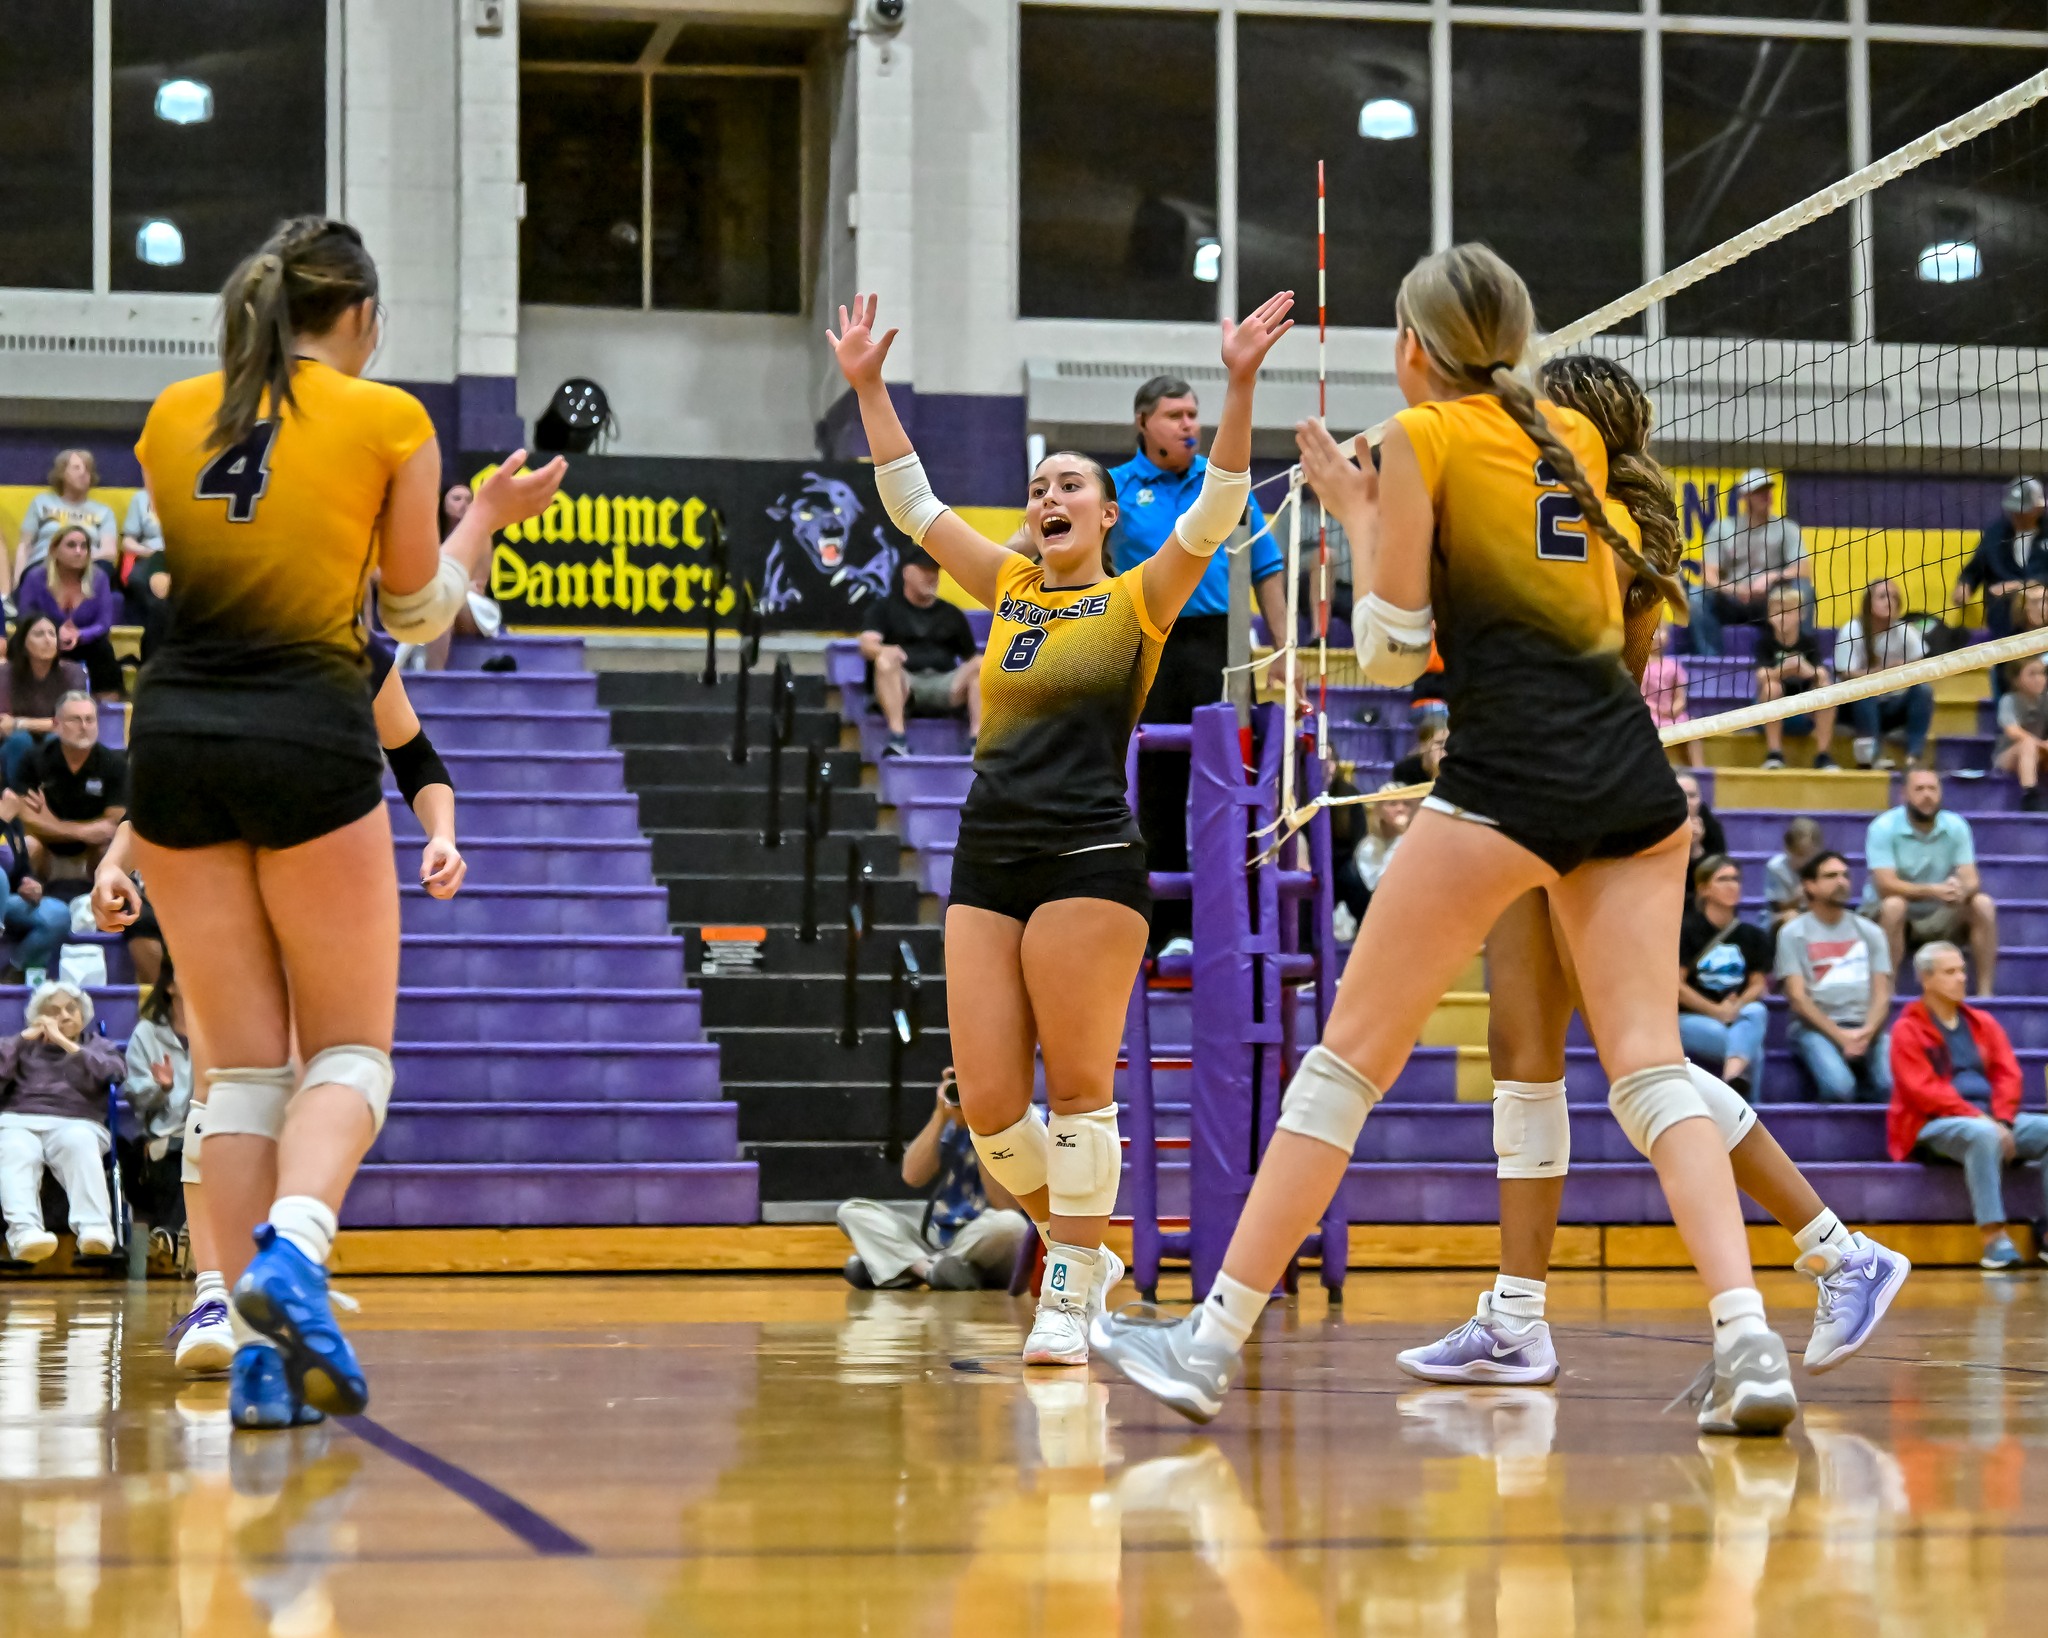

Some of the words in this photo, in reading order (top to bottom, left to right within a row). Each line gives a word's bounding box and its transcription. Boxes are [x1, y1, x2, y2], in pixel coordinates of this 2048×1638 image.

[194, 418, 281, 522] 4
[1535, 458, 1588, 561] 2
[1001, 626, 1048, 672] 8
